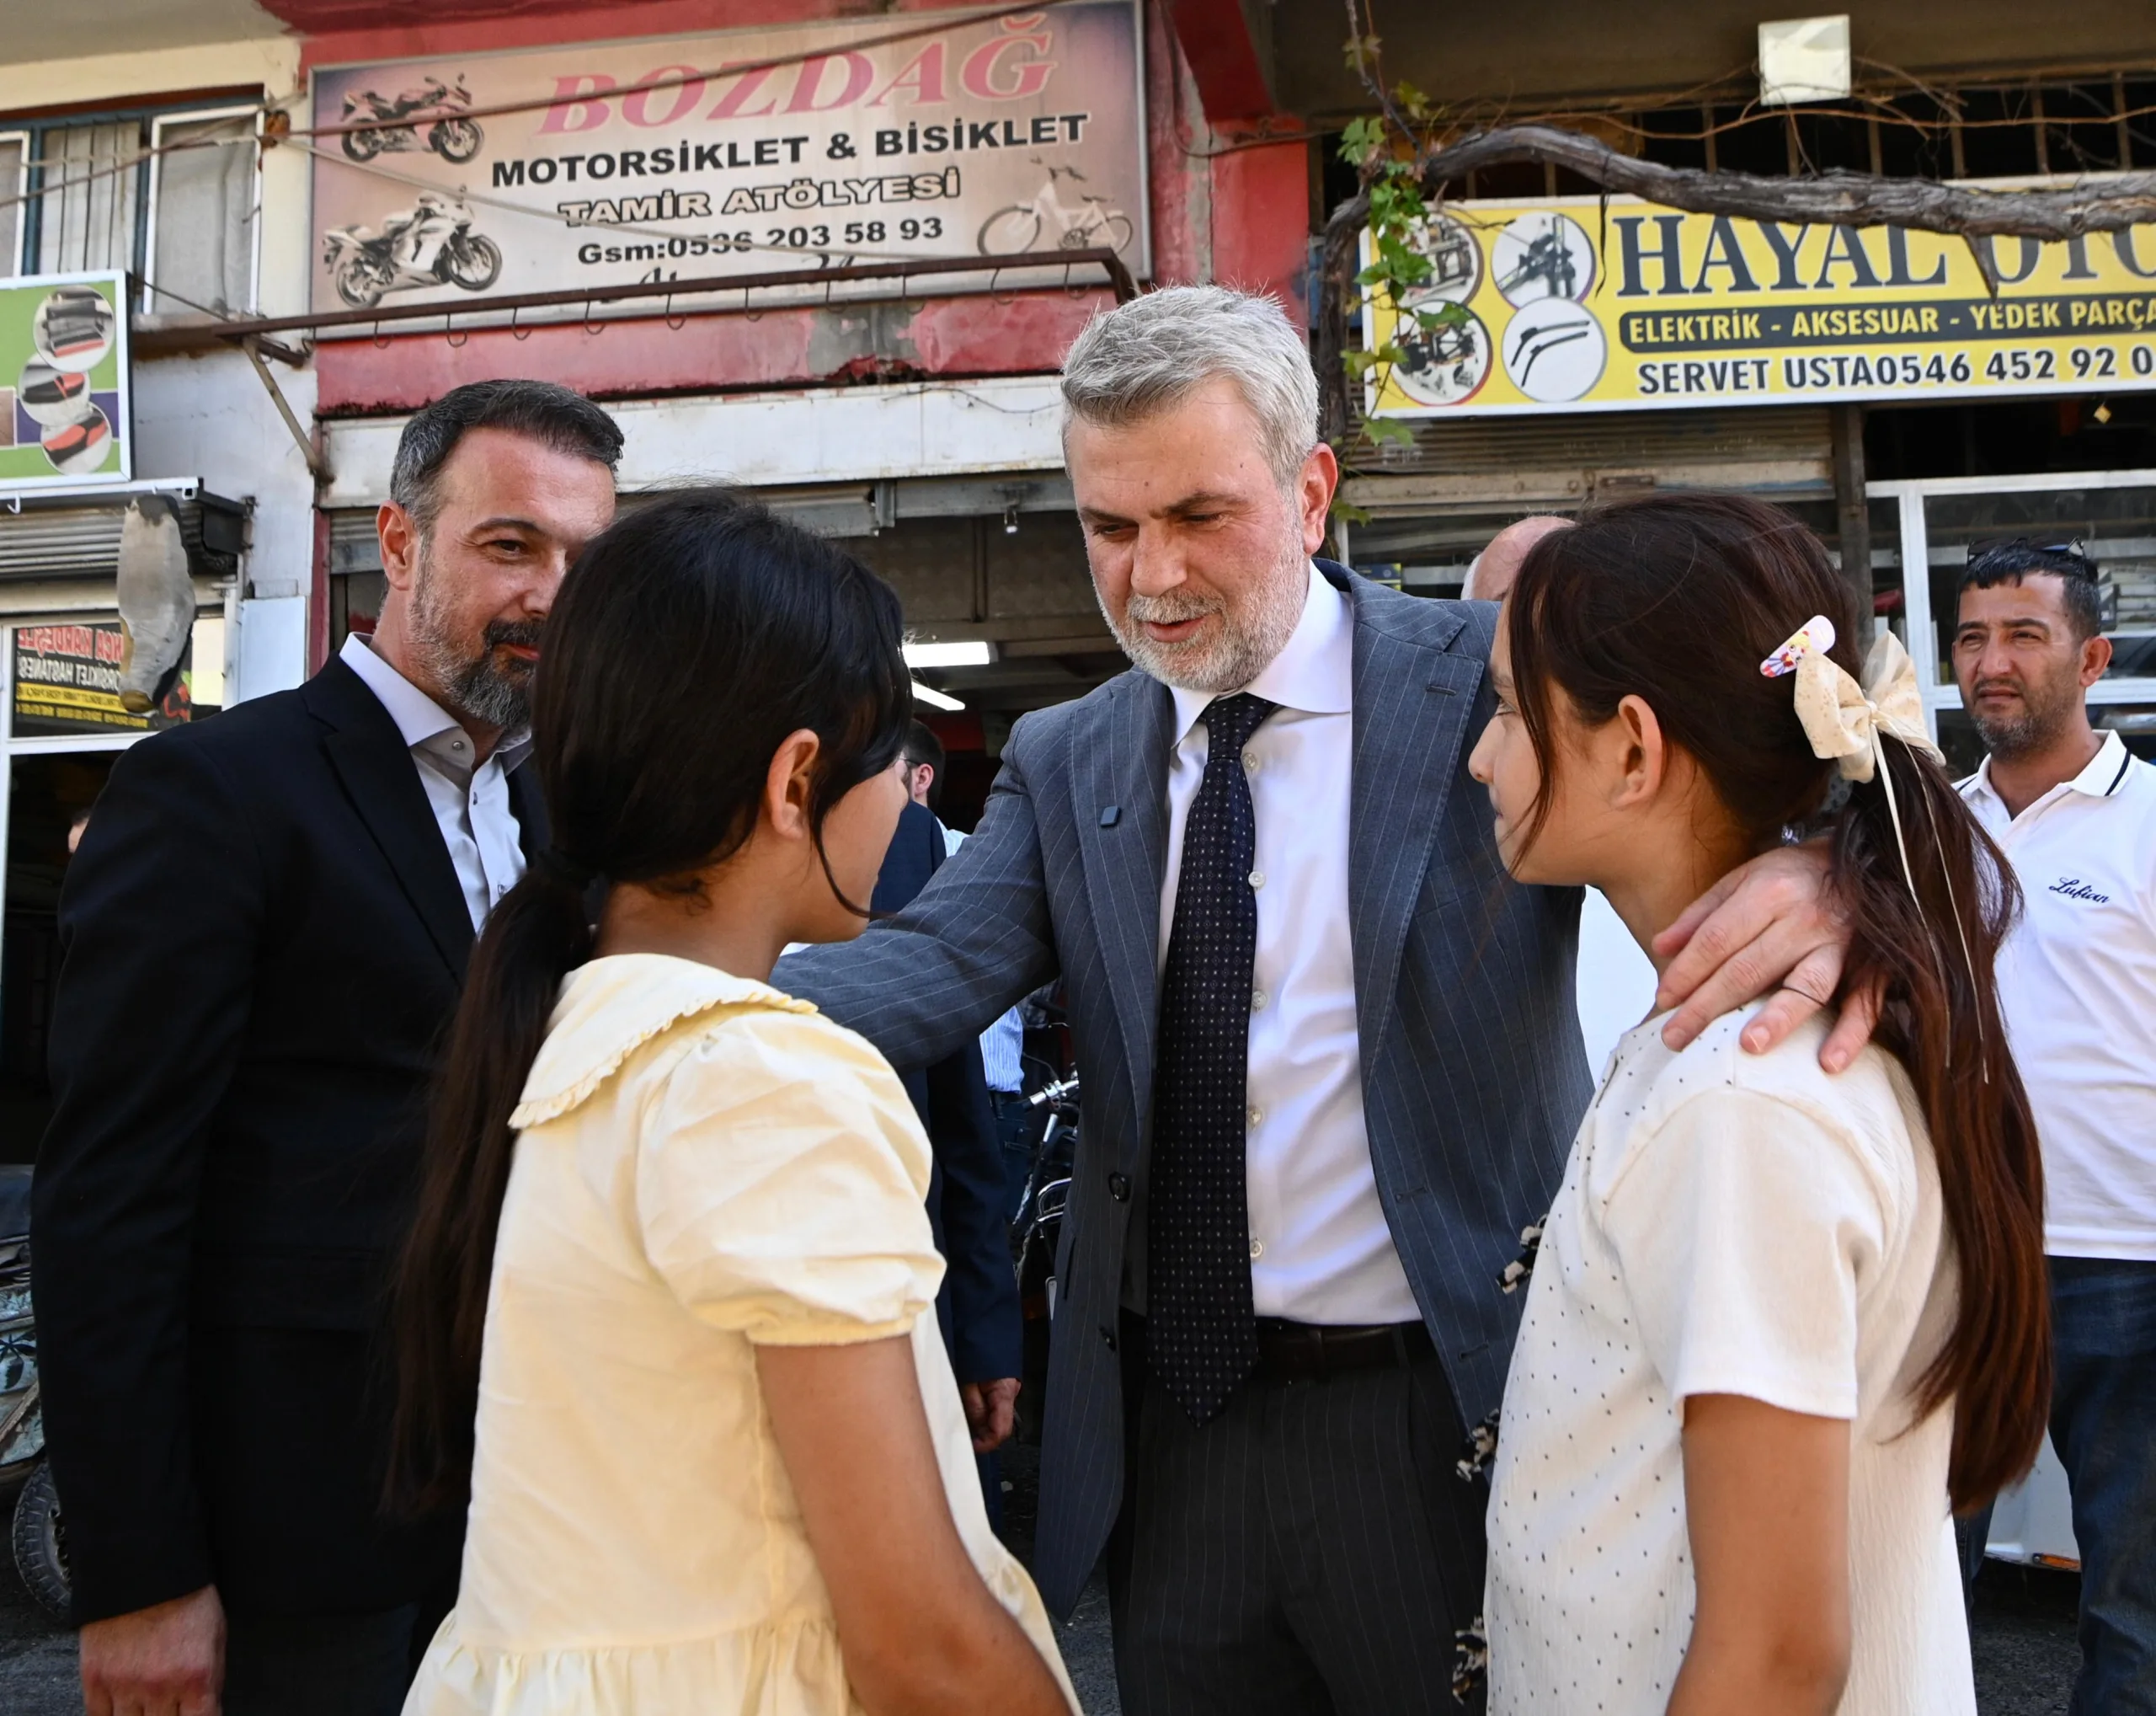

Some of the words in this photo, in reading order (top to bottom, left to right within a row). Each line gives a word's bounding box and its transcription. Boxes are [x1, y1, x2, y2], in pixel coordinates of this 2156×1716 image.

[537, 12, 1056, 136] BOZDAĞ
[492, 136, 809, 187] MOTORSİKLET
[826, 132, 857, 160] &
[876, 114, 1088, 157] BİSİKLET
[558, 189, 712, 227] TAMİR
[721, 165, 961, 214] ATÖLYESİ
[766, 225, 830, 249] 203
[845, 221, 886, 244] 58
[899, 217, 942, 240] 93
[1612, 214, 1946, 297] HAYAL
[1629, 308, 1762, 344] ELEKTRİK
[1791, 307, 1939, 337] AKSESUAR
[1969, 301, 2062, 331] YEDEK
[2070, 297, 2156, 331] PARÇA
[1638, 359, 1769, 394] SERVET
[1986, 349, 2055, 381] 452
[2070, 347, 2116, 378] 92
